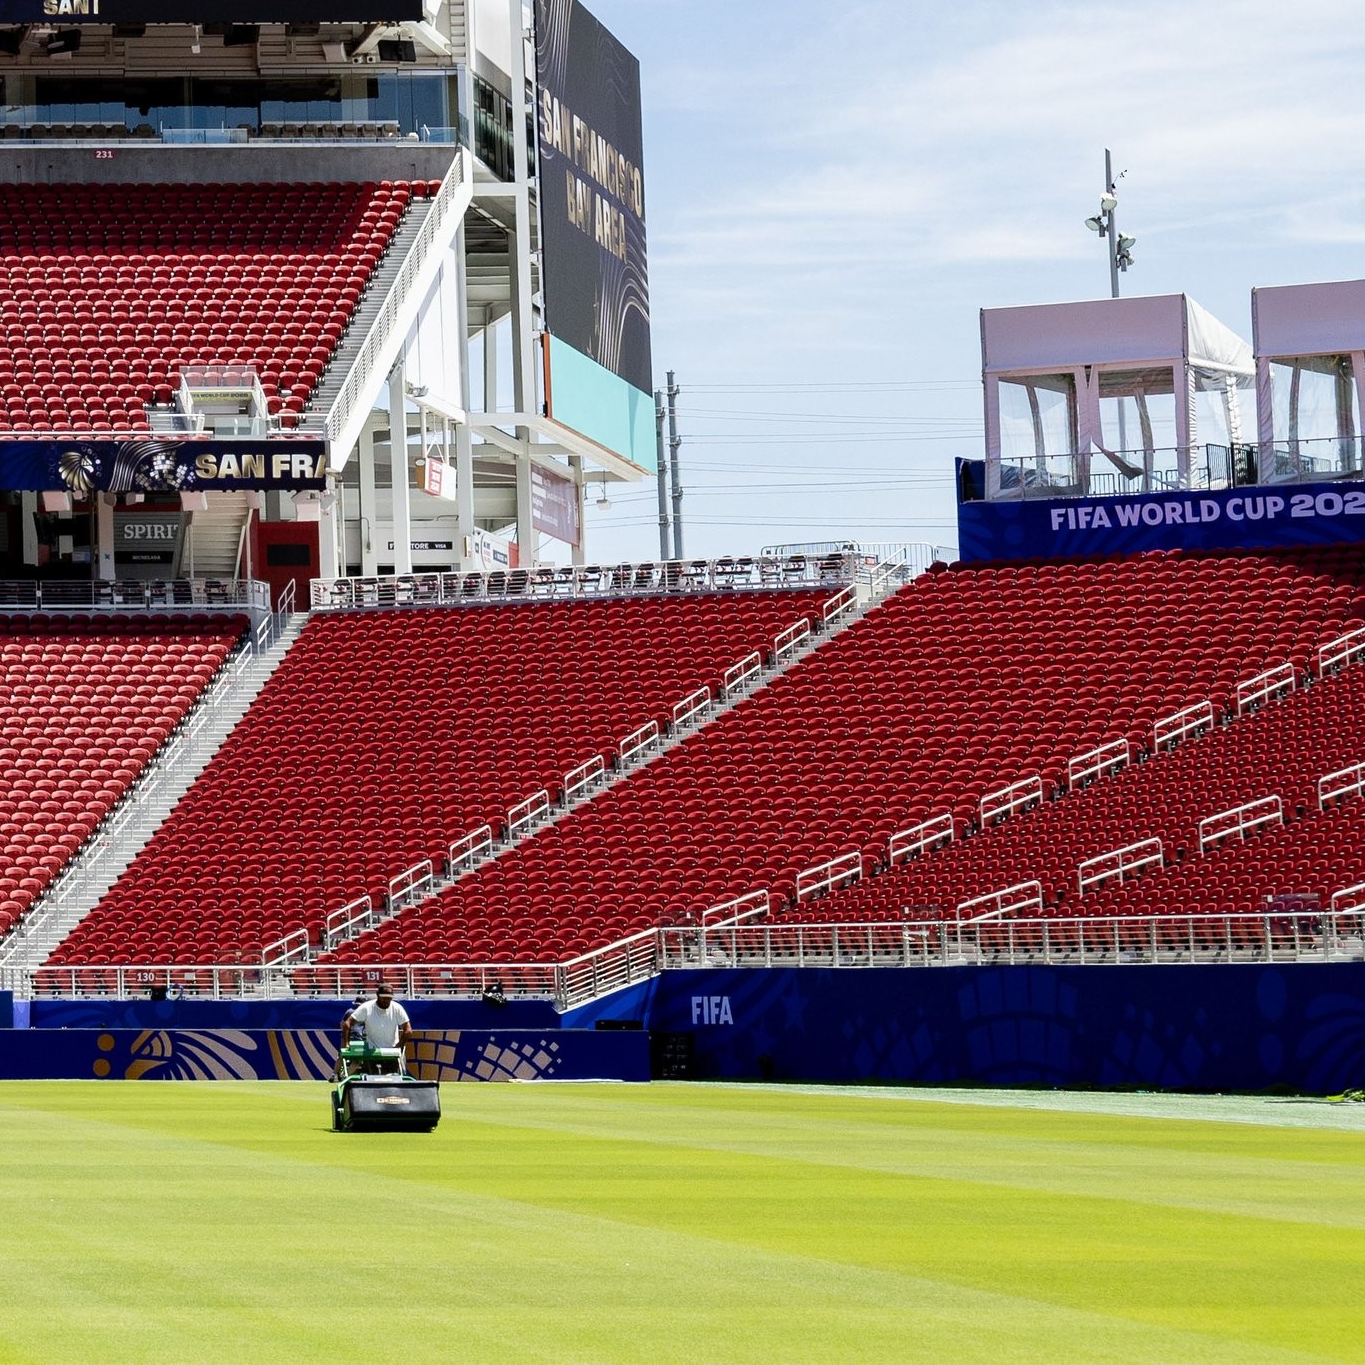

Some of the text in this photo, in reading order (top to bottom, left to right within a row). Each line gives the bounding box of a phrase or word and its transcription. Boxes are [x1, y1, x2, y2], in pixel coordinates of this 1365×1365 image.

[95, 150, 113, 159] 231
[541, 89, 643, 219] SAN FRANCISCO
[566, 171, 628, 265] BAY AREA
[195, 454, 265, 479] SAN
[1051, 506, 1111, 530] FIFA
[1114, 499, 1220, 527] WORLD
[1225, 495, 1285, 521] CUP
[137, 972, 155, 982] 130
[365, 971, 382, 981] 131
[691, 996, 734, 1025] FIFA
